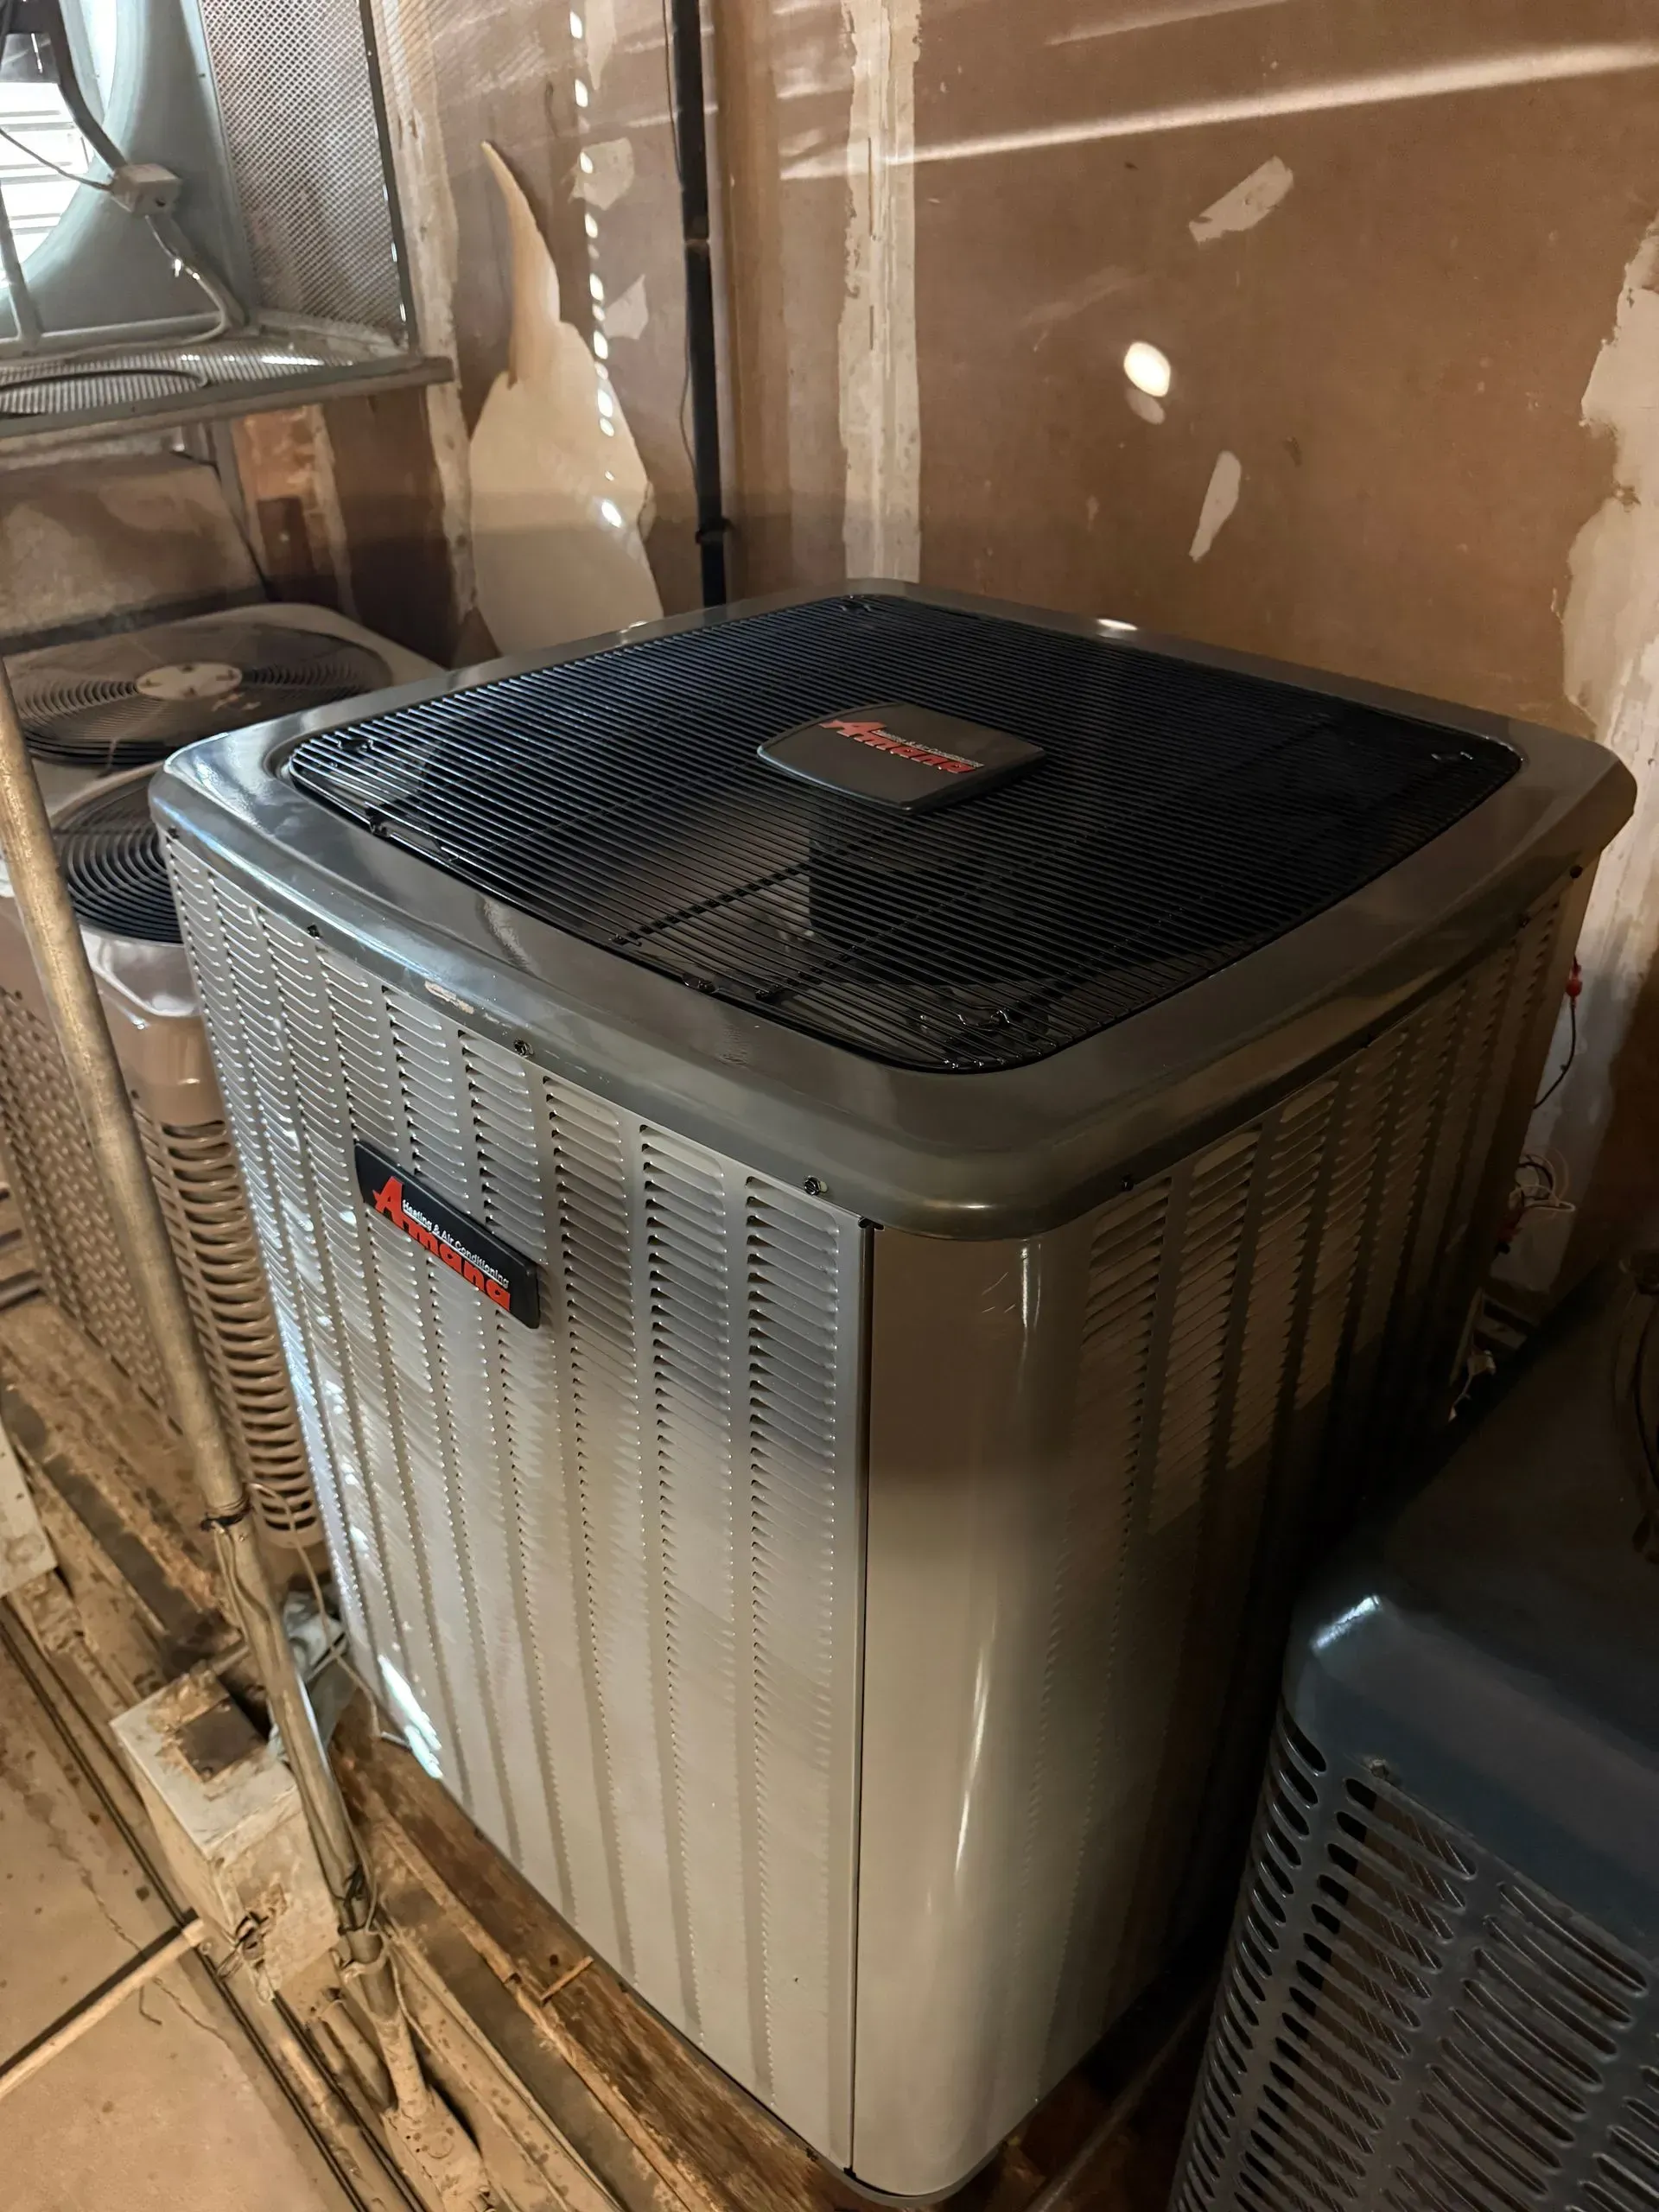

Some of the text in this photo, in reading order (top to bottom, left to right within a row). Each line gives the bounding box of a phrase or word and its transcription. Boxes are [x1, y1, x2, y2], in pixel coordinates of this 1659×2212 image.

[818, 720, 976, 773] Amana
[372, 1176, 511, 1312] Amana
[403, 1199, 509, 1288] Heating & Air Conditioning
